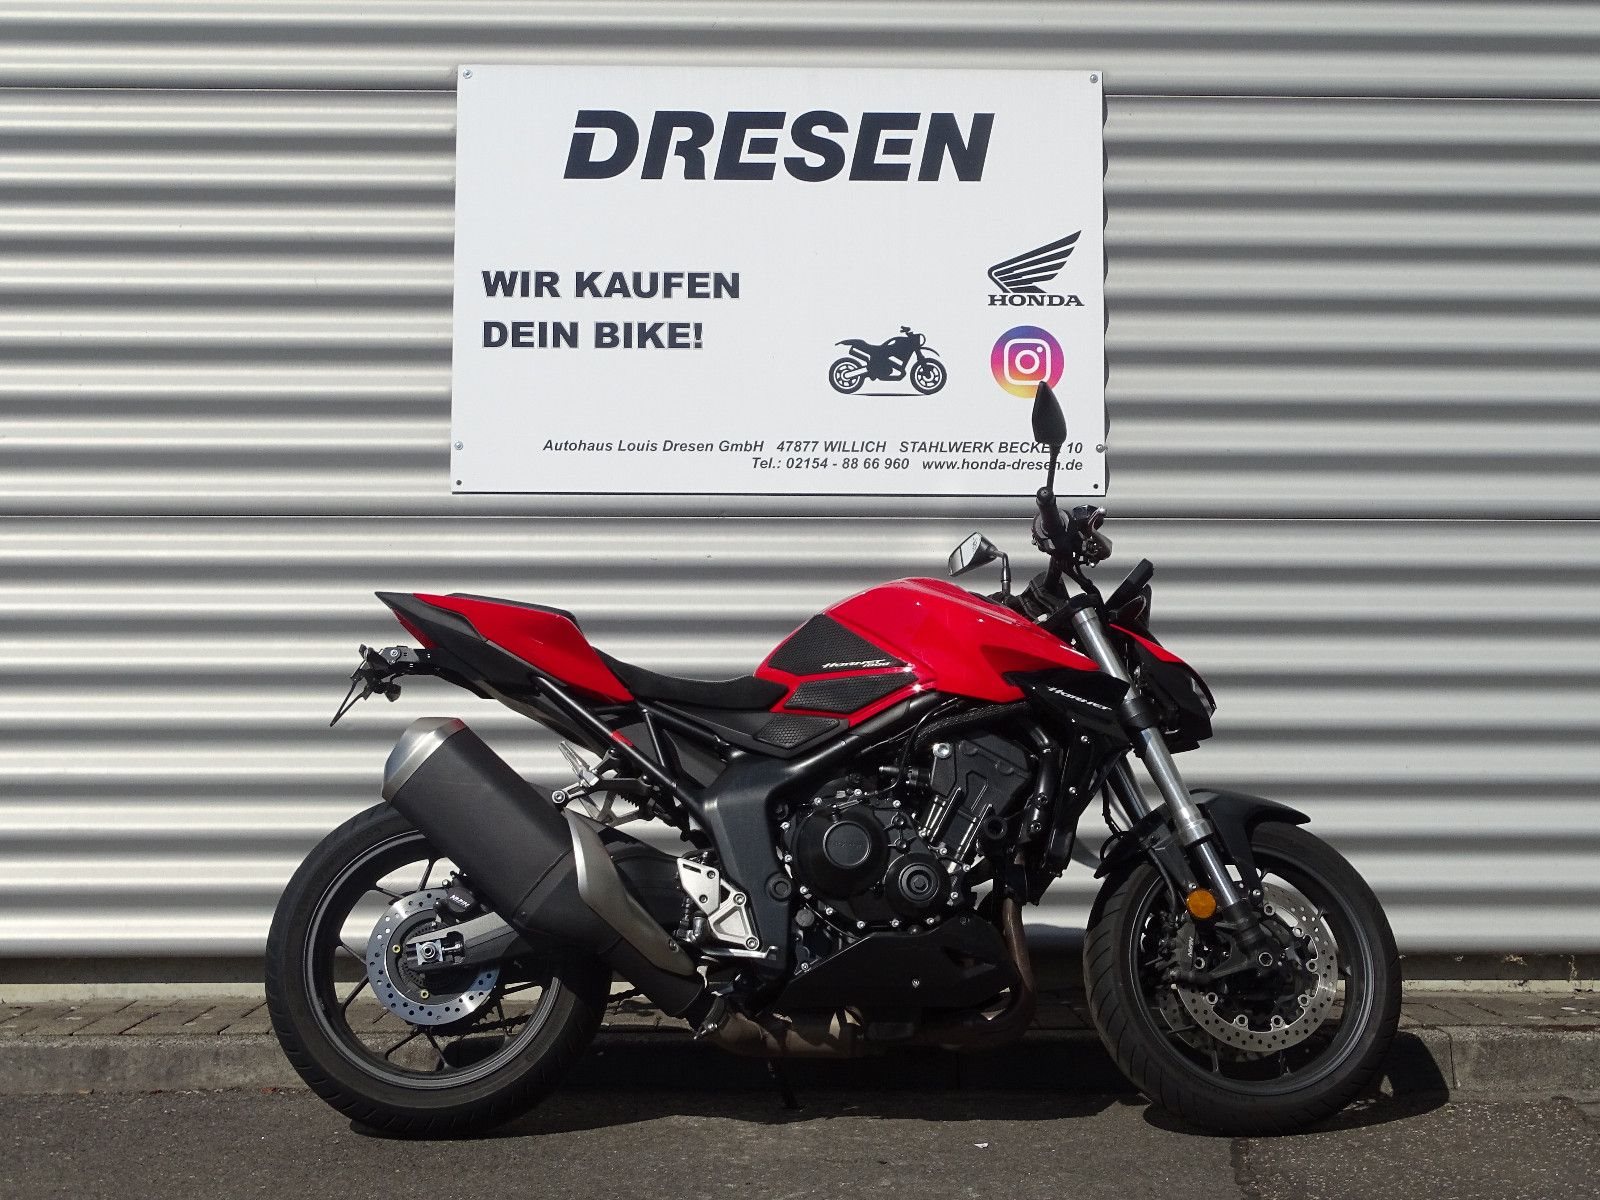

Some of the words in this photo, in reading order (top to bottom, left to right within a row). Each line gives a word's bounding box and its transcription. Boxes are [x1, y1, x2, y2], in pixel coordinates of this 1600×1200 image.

[564, 109, 995, 183] DRESEN
[482, 270, 561, 299] WIR
[575, 271, 740, 299] KAUFEN
[987, 294, 1085, 307] HONDA
[482, 321, 579, 349] DEIN
[594, 321, 704, 350] BIKE!
[542, 439, 614, 453] Autohaus
[617, 439, 659, 453] Louis
[662, 439, 714, 453] Dresen
[718, 439, 765, 453] GmbH
[776, 440, 820, 453] 47877
[824, 440, 887, 453] WILLICH
[899, 440, 995, 454] STAHLWERK
[998, 441, 1061, 454] BECKE
[1066, 441, 1083, 454] 10
[752, 456, 782, 470] Tel.:
[785, 457, 829, 470] 02154
[841, 457, 859, 470] 88
[863, 457, 880, 470] 66
[884, 457, 910, 470] 960
